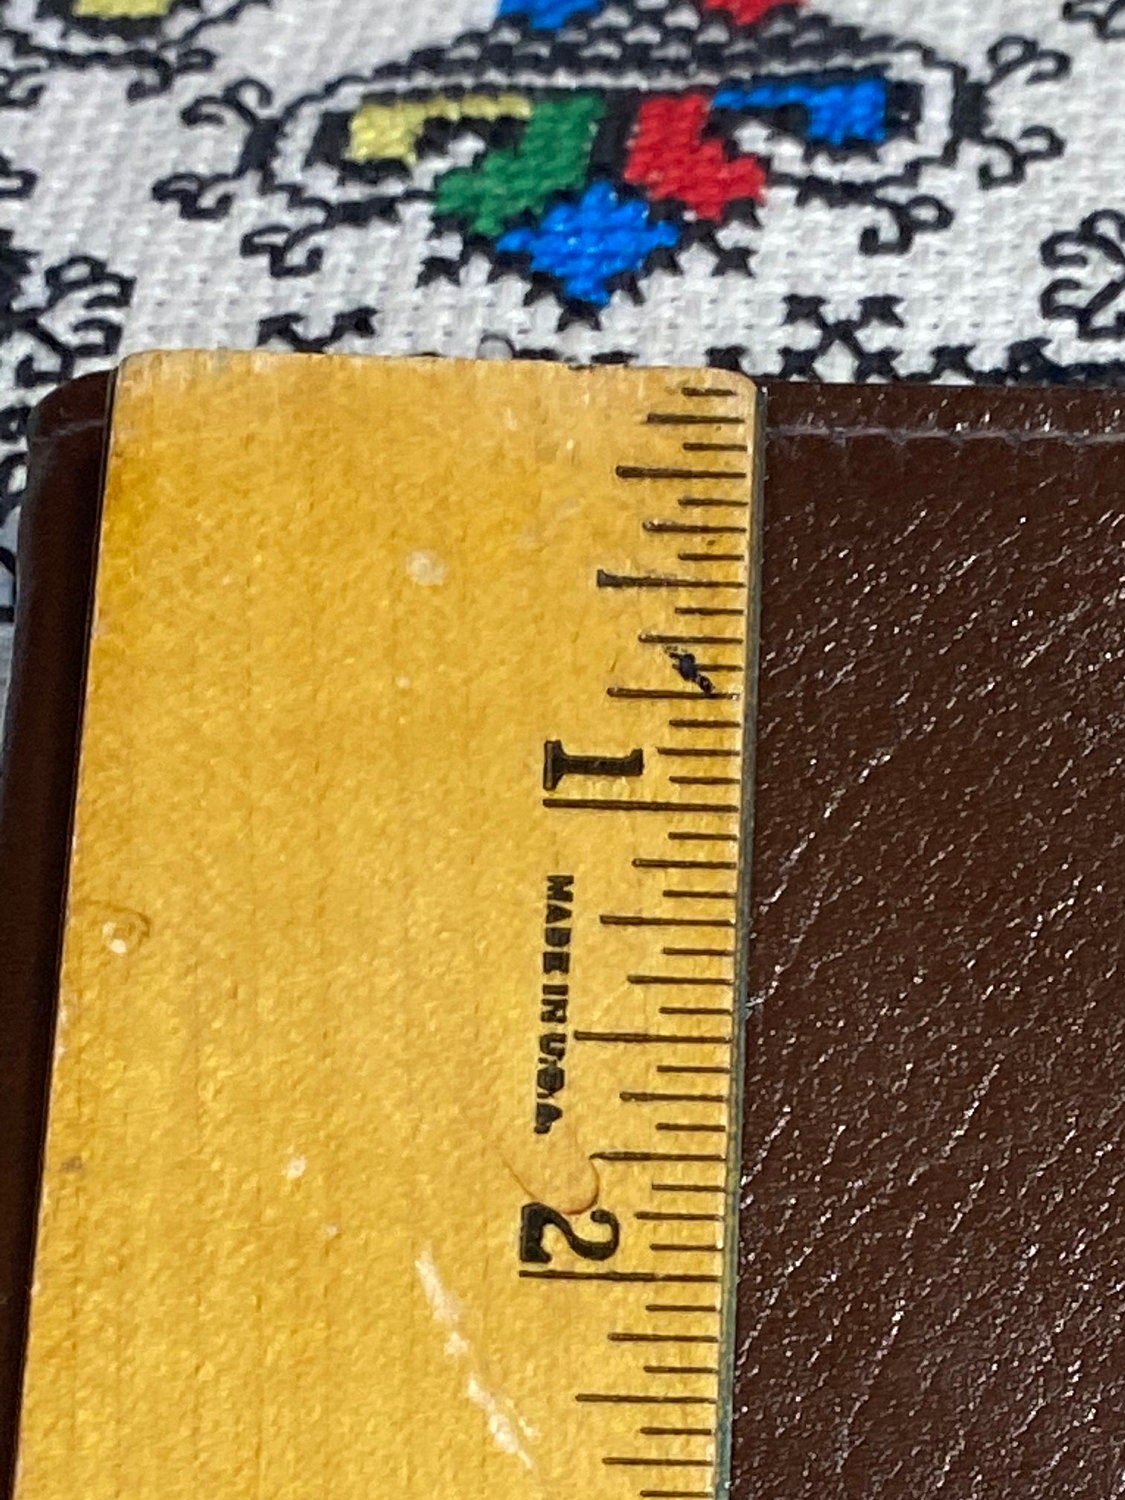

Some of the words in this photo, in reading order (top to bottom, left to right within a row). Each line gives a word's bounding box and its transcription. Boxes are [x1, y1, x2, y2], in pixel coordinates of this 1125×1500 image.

[543, 739, 644, 791] 1
[541, 874, 575, 975] MADE
[540, 984, 569, 1024] IN
[519, 1202, 620, 1264] 2
